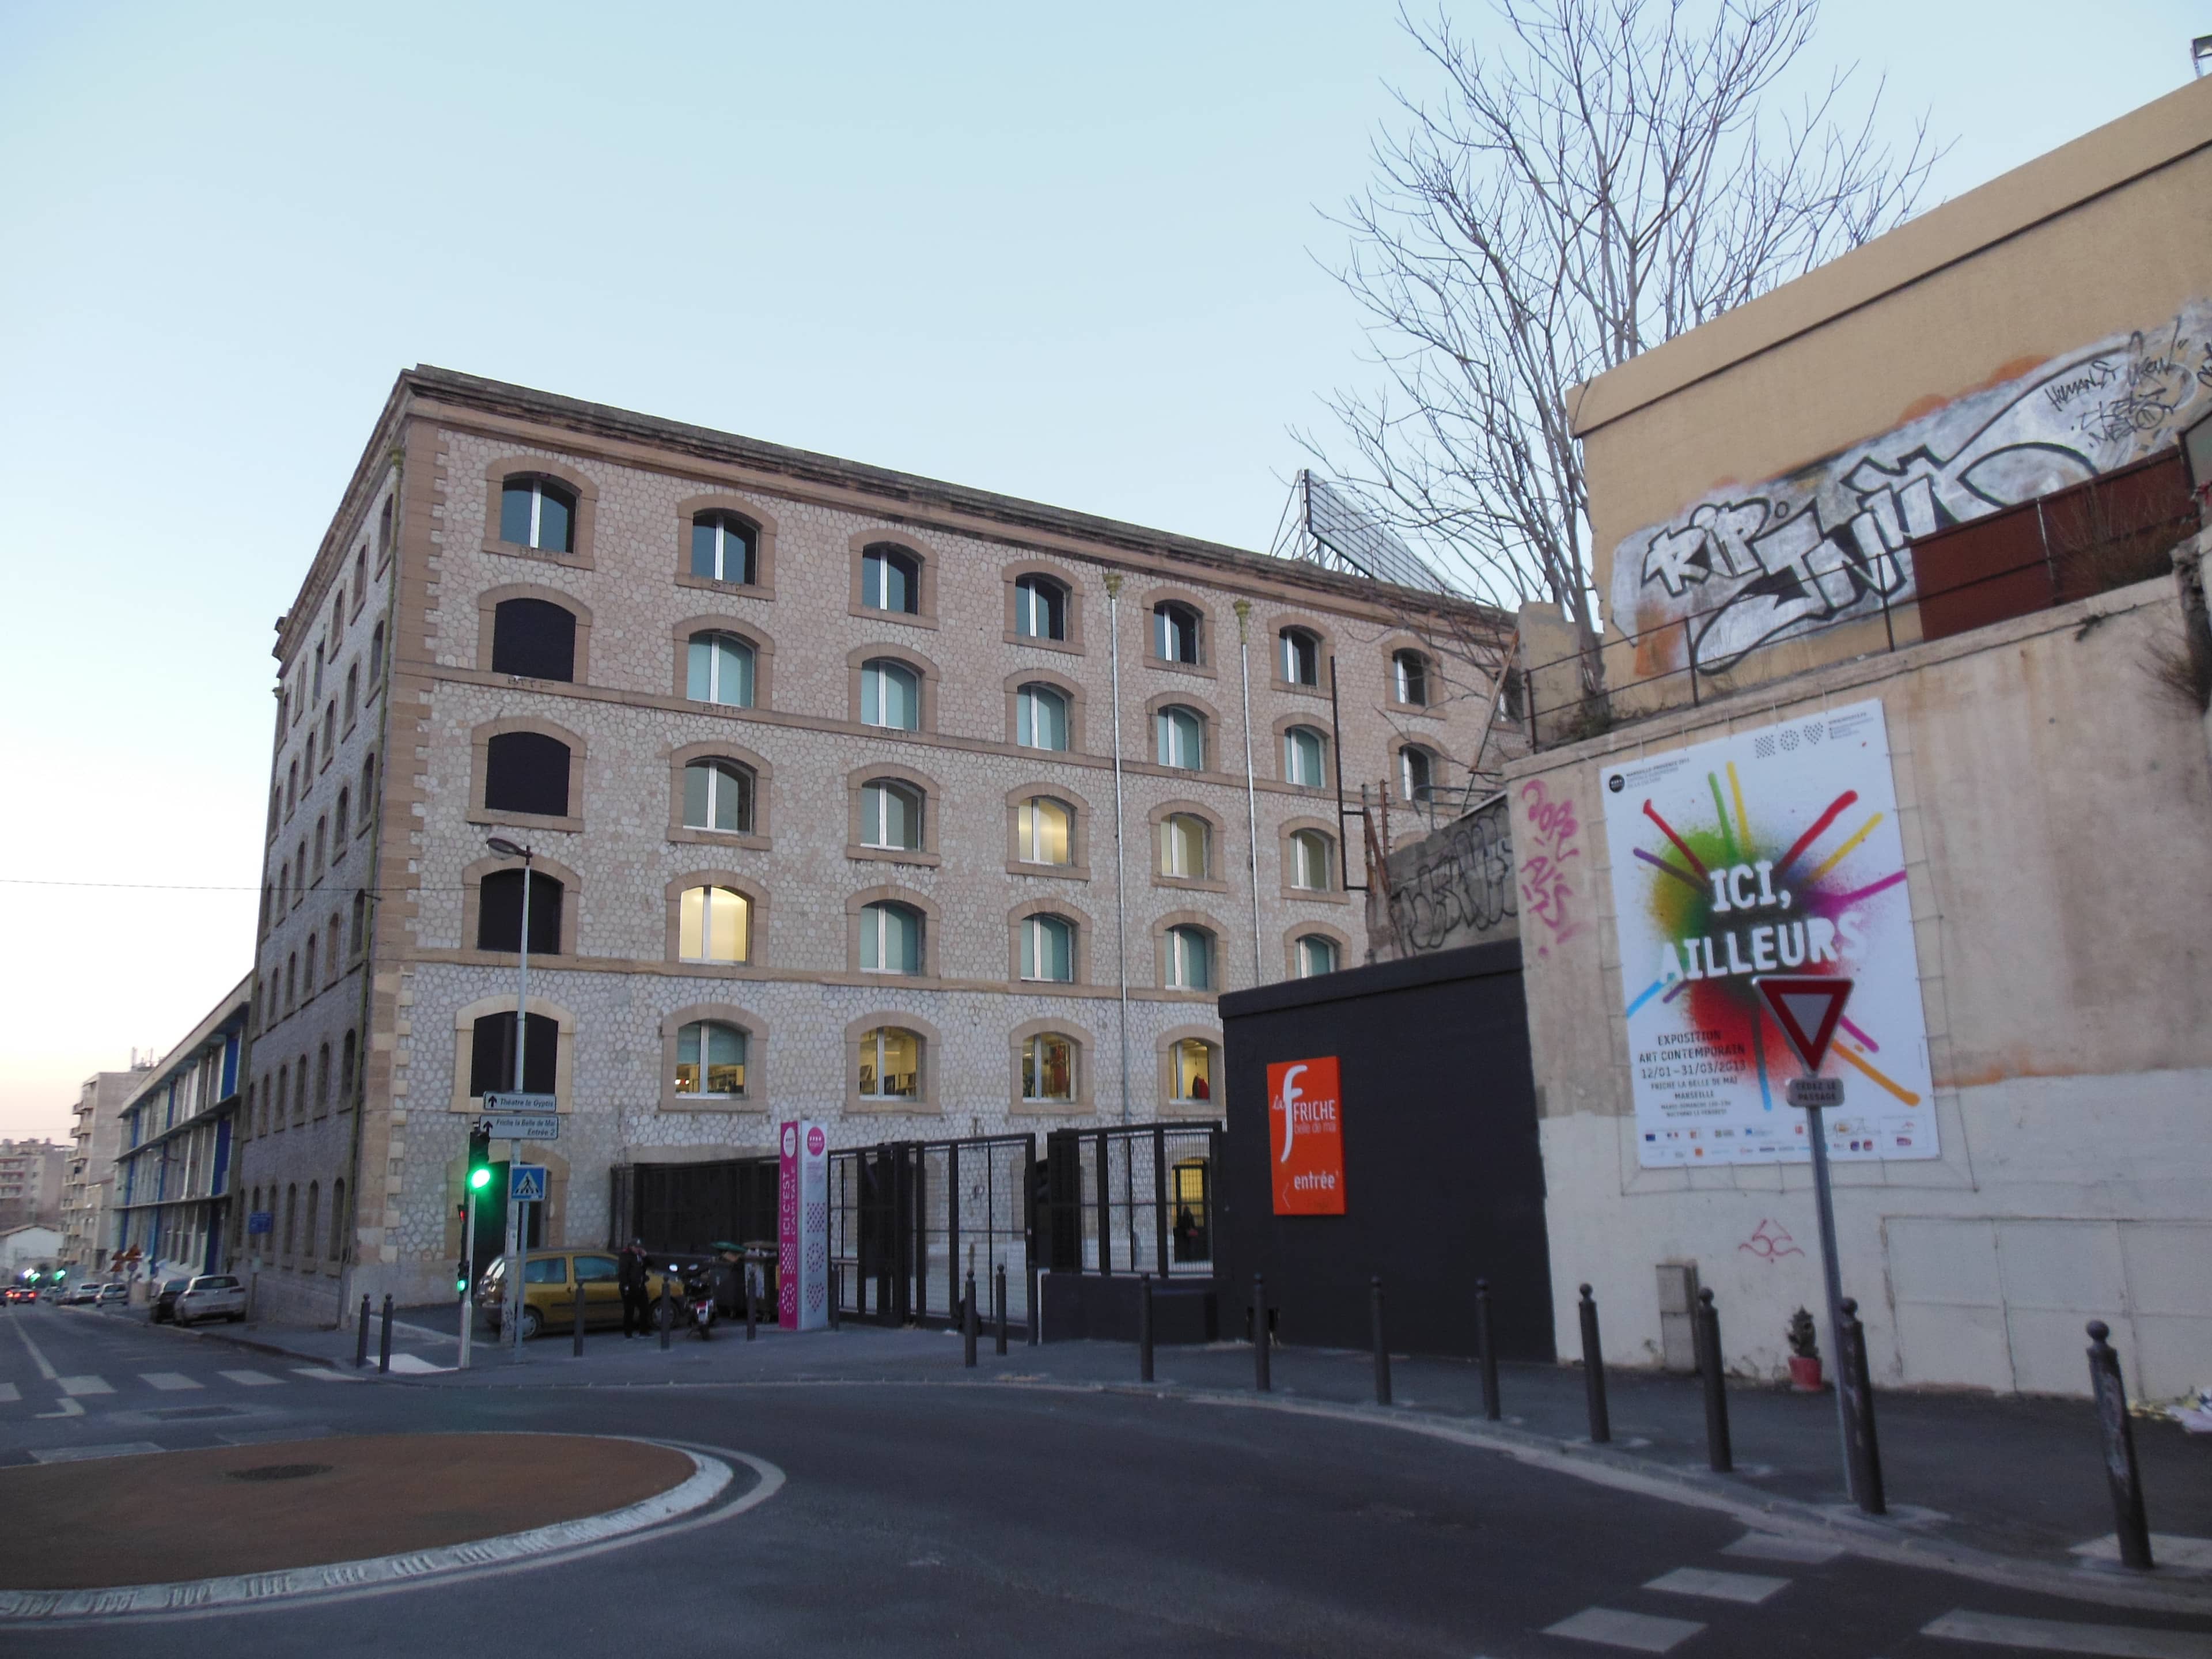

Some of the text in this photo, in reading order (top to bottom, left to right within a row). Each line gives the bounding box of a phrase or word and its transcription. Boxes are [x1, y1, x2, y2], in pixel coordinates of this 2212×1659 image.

[1709, 860, 1792, 912] ICI,
[1660, 910, 1866, 984] AILLEURS
[1657, 1030, 1721, 1046] EXPOSITION
[1639, 1043, 1746, 1063] ART CONTEMPORAIN
[1650, 1081, 1675, 1090] FRICHE
[1688, 1078, 1709, 1088] BELLE
[1711, 1078, 1720, 1086] DE
[1674, 1090, 1714, 1100] MARSEILLE
[1294, 1099, 1336, 1122] FRICHE
[527, 1128, 548, 1136] Entrée
[1294, 1171, 1335, 1190] entrée
